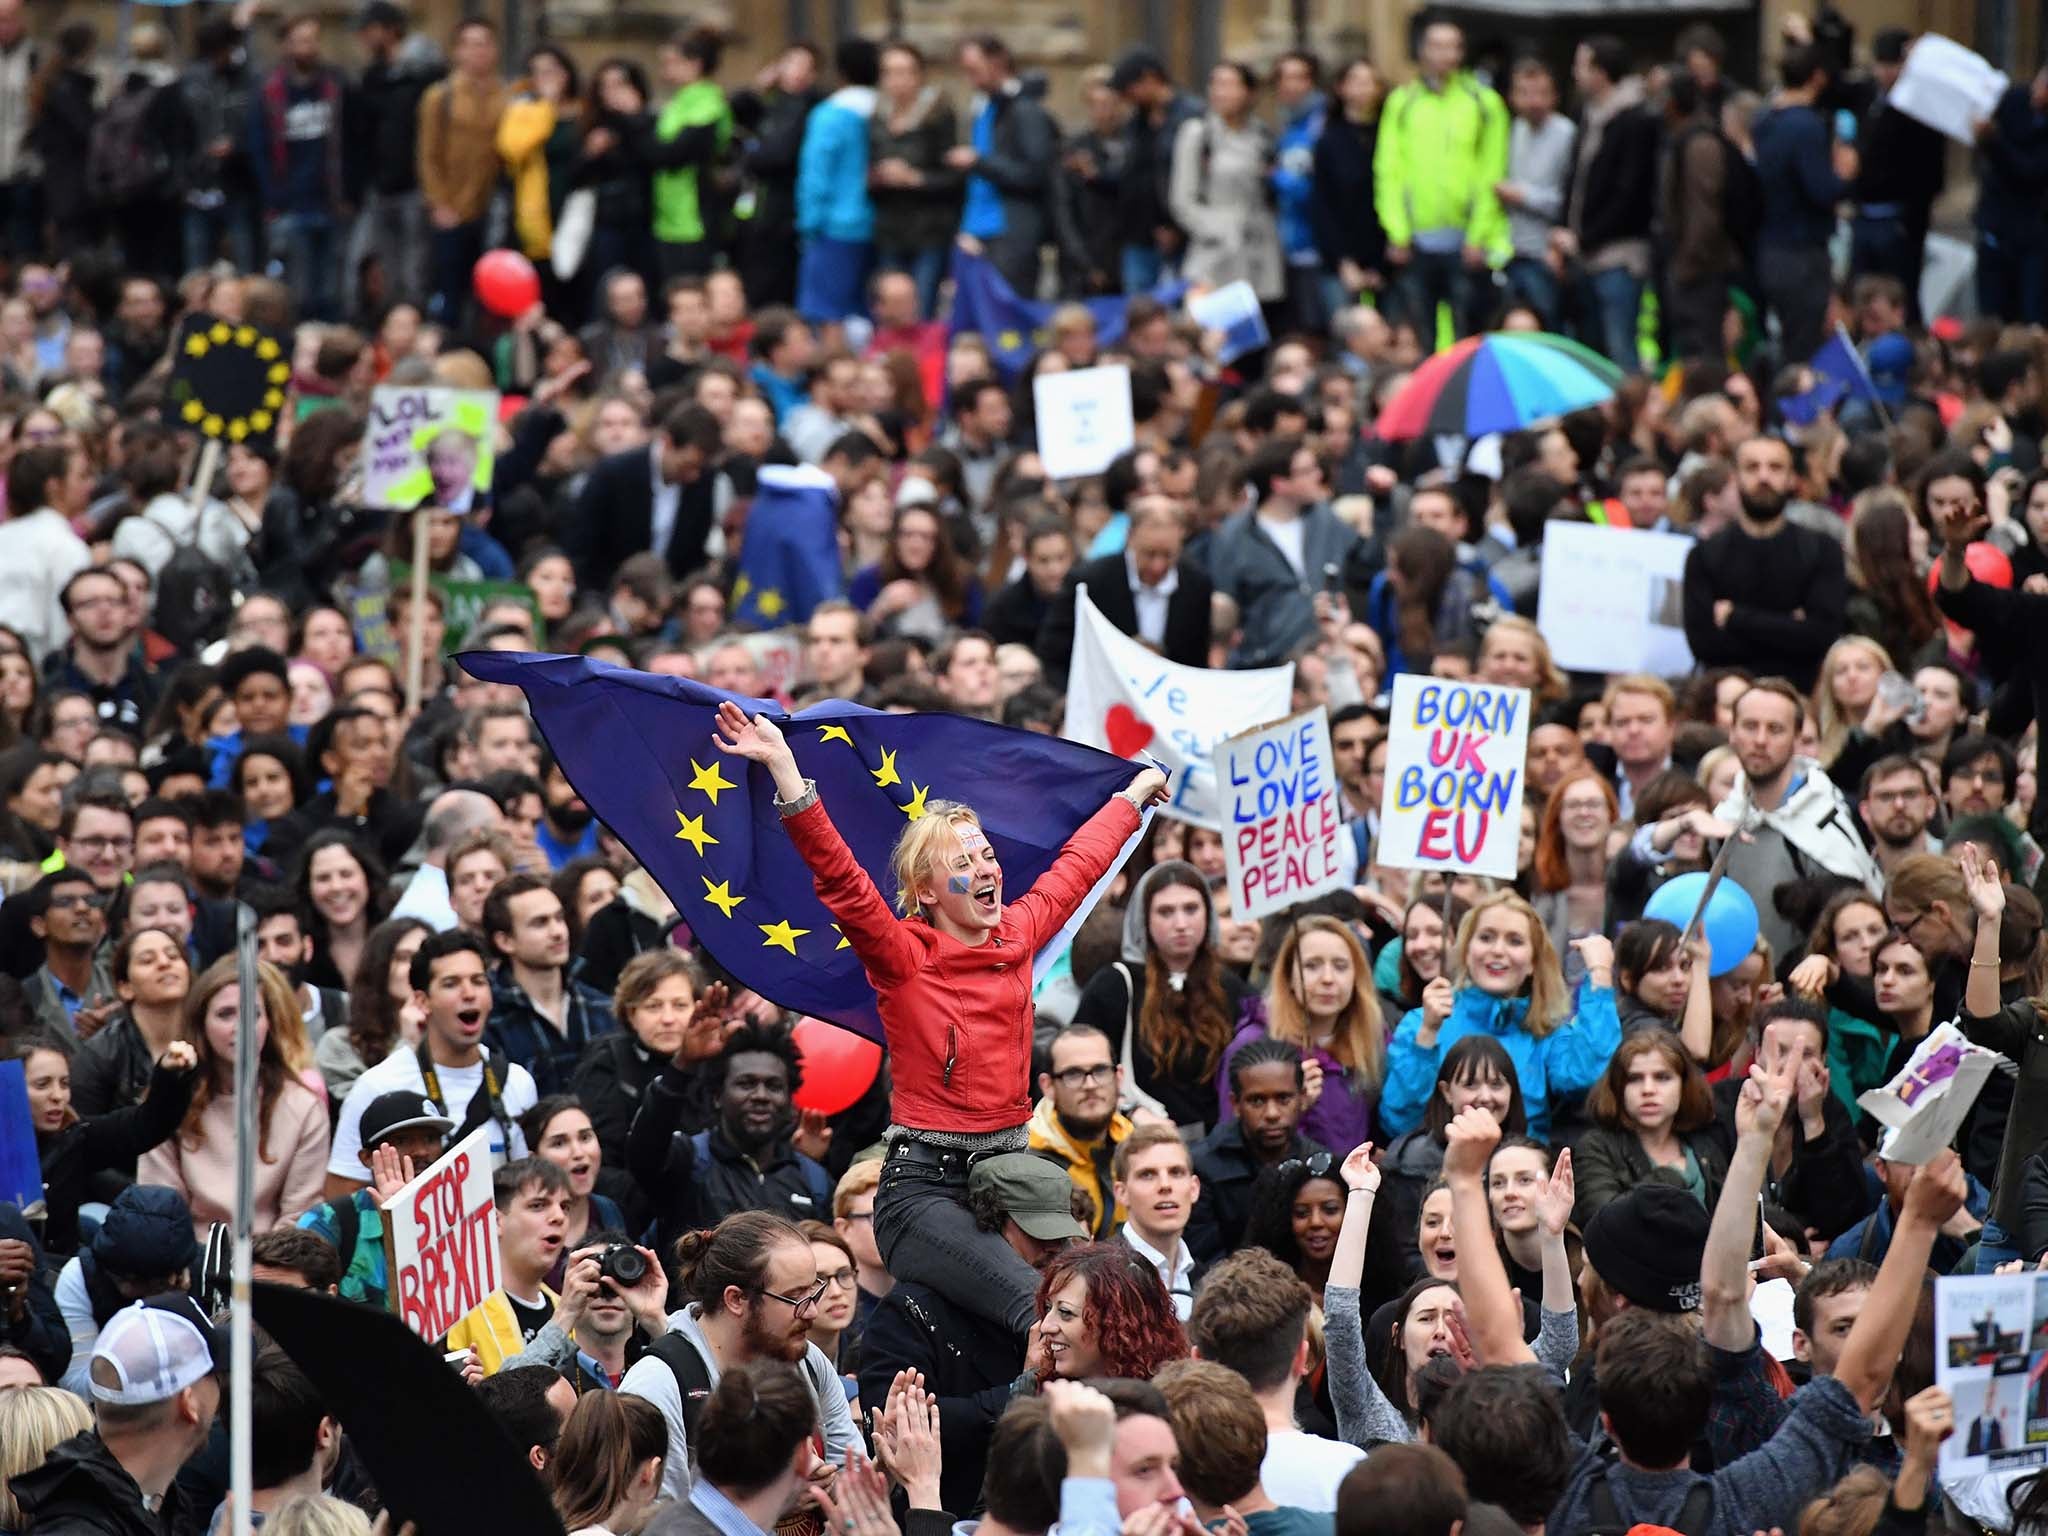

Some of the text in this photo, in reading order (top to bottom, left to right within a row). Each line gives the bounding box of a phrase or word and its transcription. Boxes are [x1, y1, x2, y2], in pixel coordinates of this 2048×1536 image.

[372, 396, 443, 426] LOL
[1413, 685, 1519, 736] BORN
[1231, 721, 1317, 786] LOVE
[1429, 728, 1489, 774] UK
[1234, 762, 1321, 823] LOVE
[1396, 765, 1516, 819] BORN
[1238, 789, 1336, 866] PEACE
[1418, 810, 1489, 863] EU
[1243, 835, 1338, 909] PEACE
[414, 1151, 470, 1253] STOP
[400, 1198, 495, 1344] BREXIT
